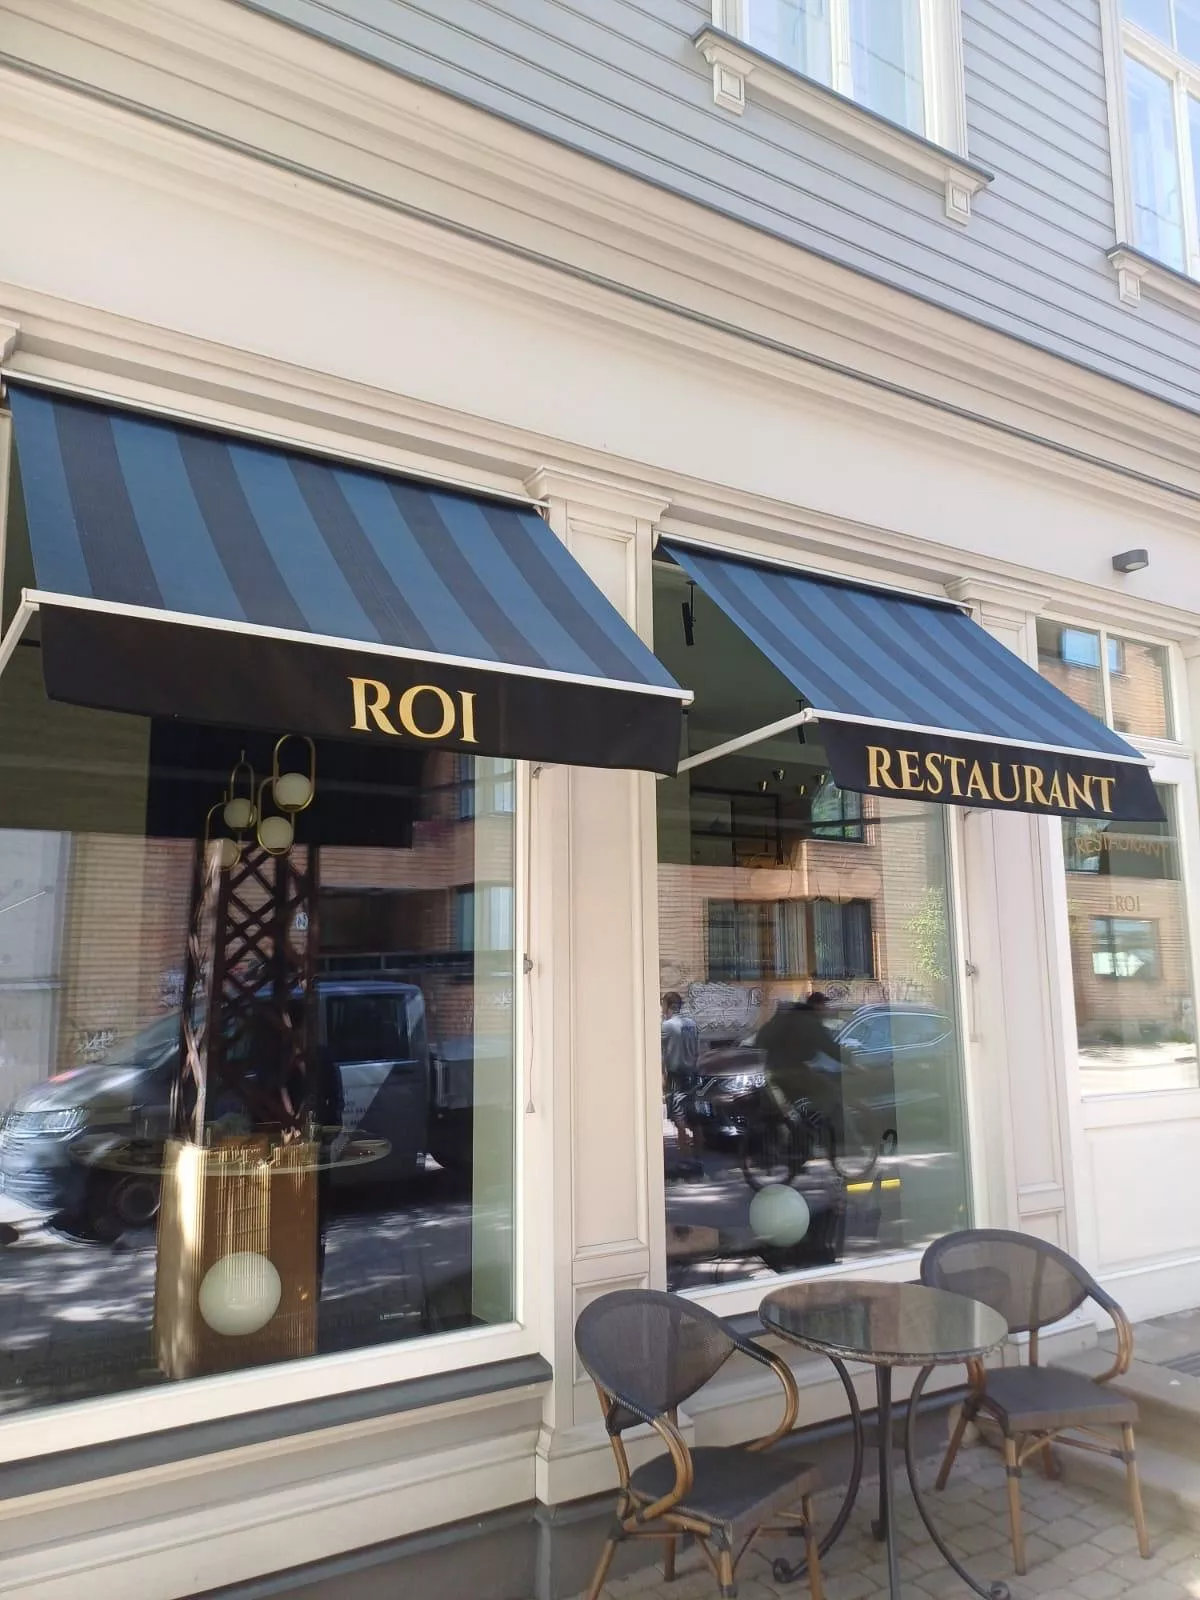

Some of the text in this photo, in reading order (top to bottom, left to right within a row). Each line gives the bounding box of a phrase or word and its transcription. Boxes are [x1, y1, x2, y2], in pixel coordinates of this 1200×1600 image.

[347, 676, 480, 744] ROI
[865, 745, 1116, 813] RESTAURANT
[1114, 895, 1141, 912] ROI
